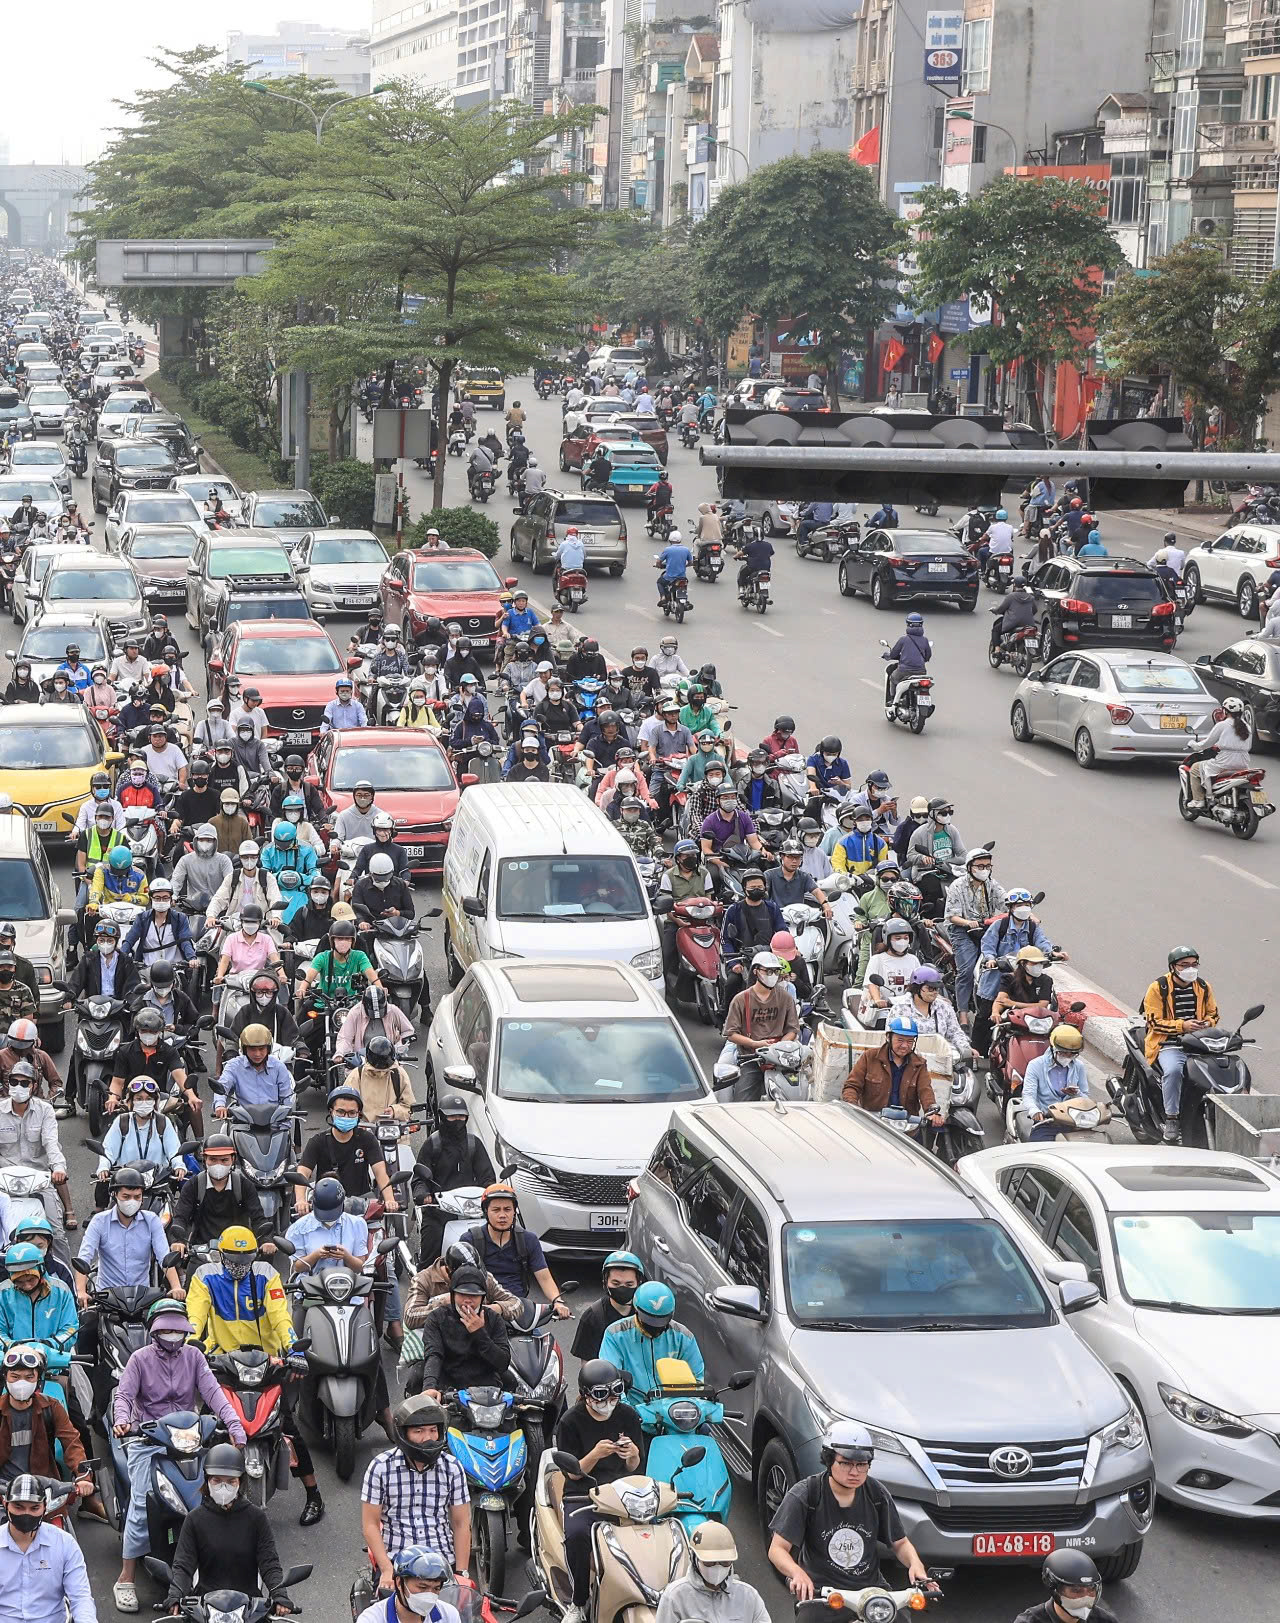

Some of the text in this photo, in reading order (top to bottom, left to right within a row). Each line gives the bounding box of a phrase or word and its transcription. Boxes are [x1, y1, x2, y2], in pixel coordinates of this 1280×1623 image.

[933, 53, 953, 66] 363
[234, 1238, 247, 1247] be
[1065, 1536, 1096, 1547] NM-34
